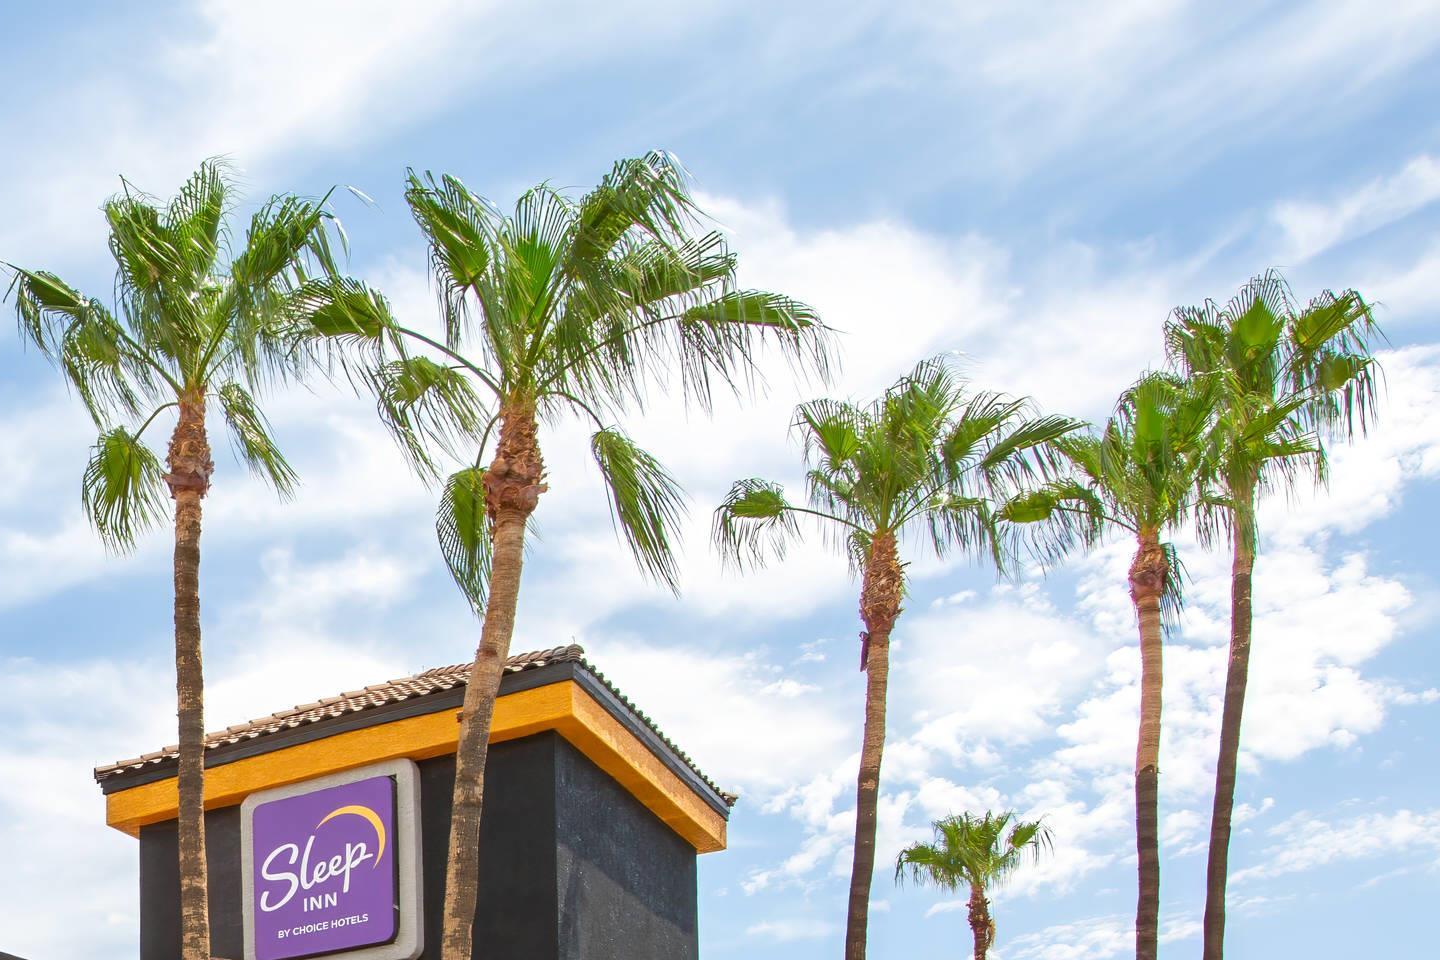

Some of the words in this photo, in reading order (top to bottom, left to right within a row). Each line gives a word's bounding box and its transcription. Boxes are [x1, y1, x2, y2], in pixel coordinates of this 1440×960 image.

[260, 835, 374, 912] Sleep
[303, 892, 338, 912] INN
[277, 928, 291, 939] BY
[292, 921, 329, 936] CHOICE
[331, 913, 369, 929] HOTELS
